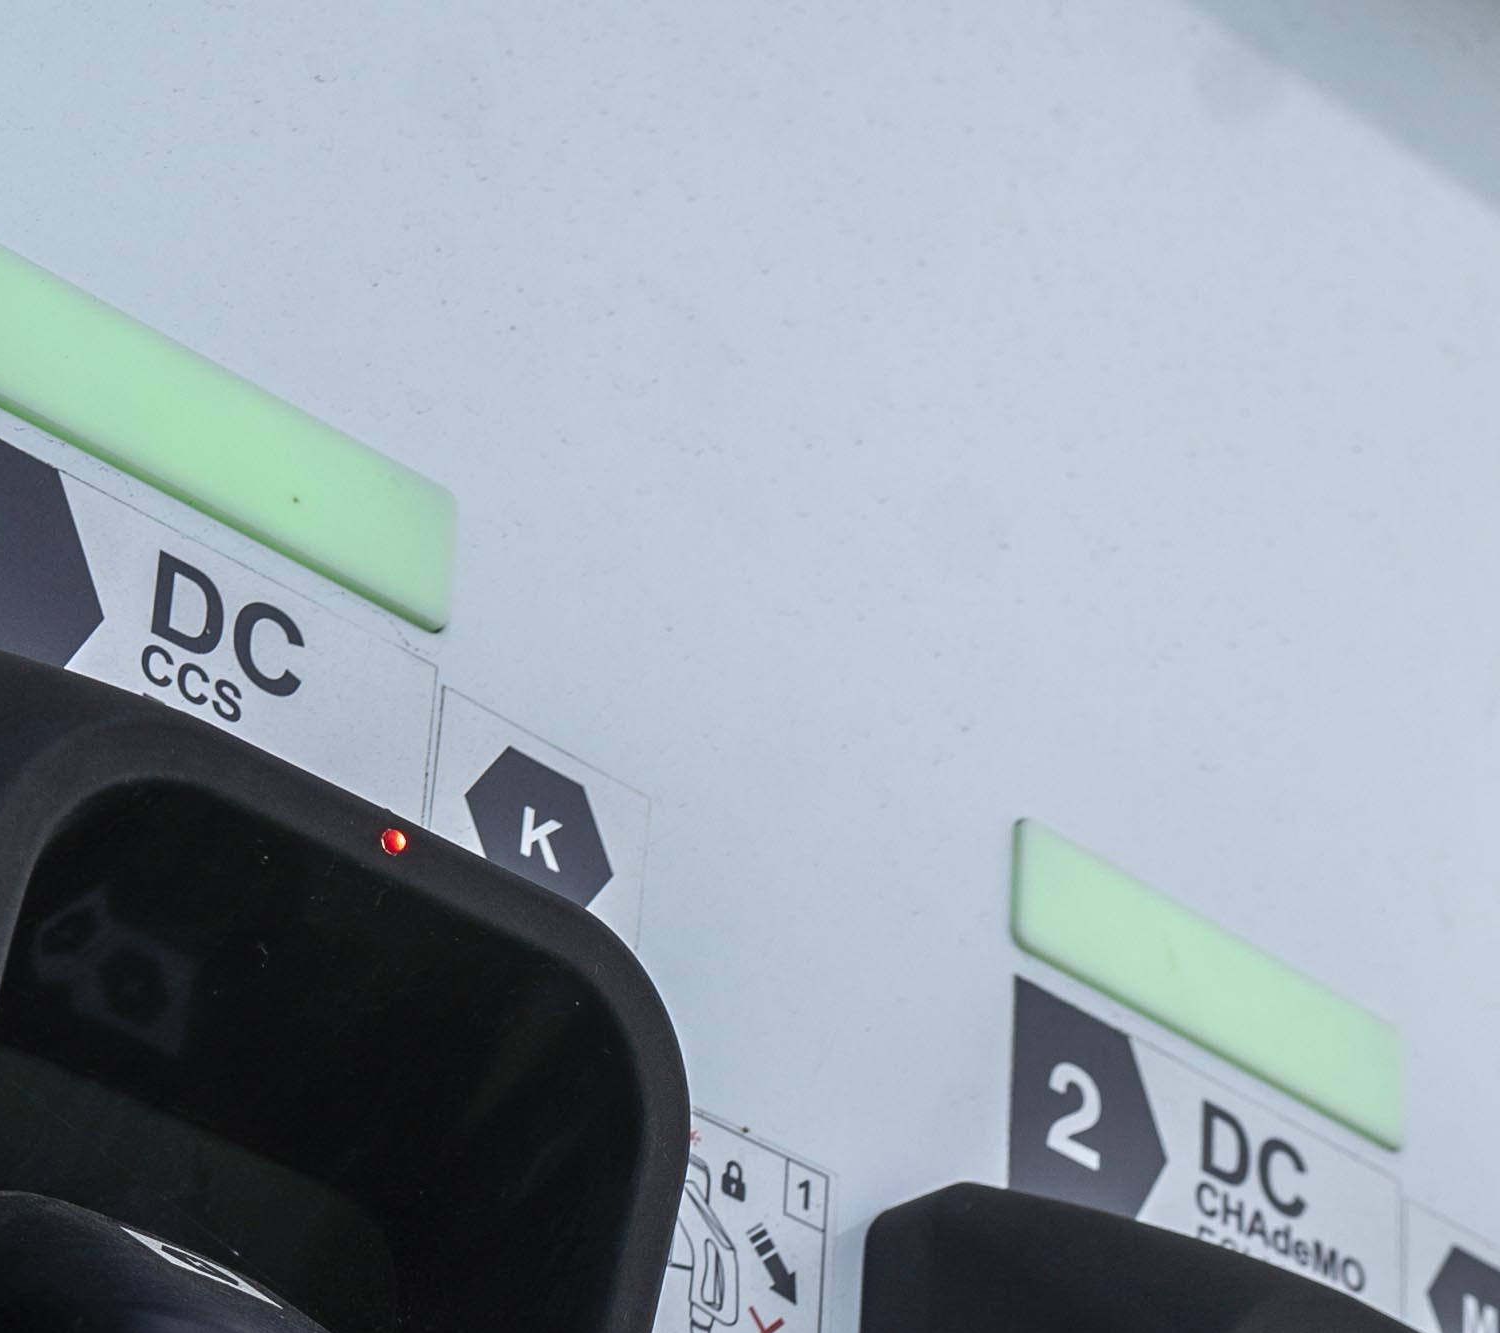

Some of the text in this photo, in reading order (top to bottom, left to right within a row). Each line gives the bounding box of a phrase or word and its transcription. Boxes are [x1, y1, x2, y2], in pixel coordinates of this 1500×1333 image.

[150, 549, 306, 698] DC
[140, 643, 243, 724] CCS
[519, 806, 563, 873] K
[1044, 1061, 1102, 1171] 2
[1200, 1099, 1307, 1220] DC
[797, 1180, 811, 1211] 1
[1196, 1180, 1367, 1293] CHAdeMO
